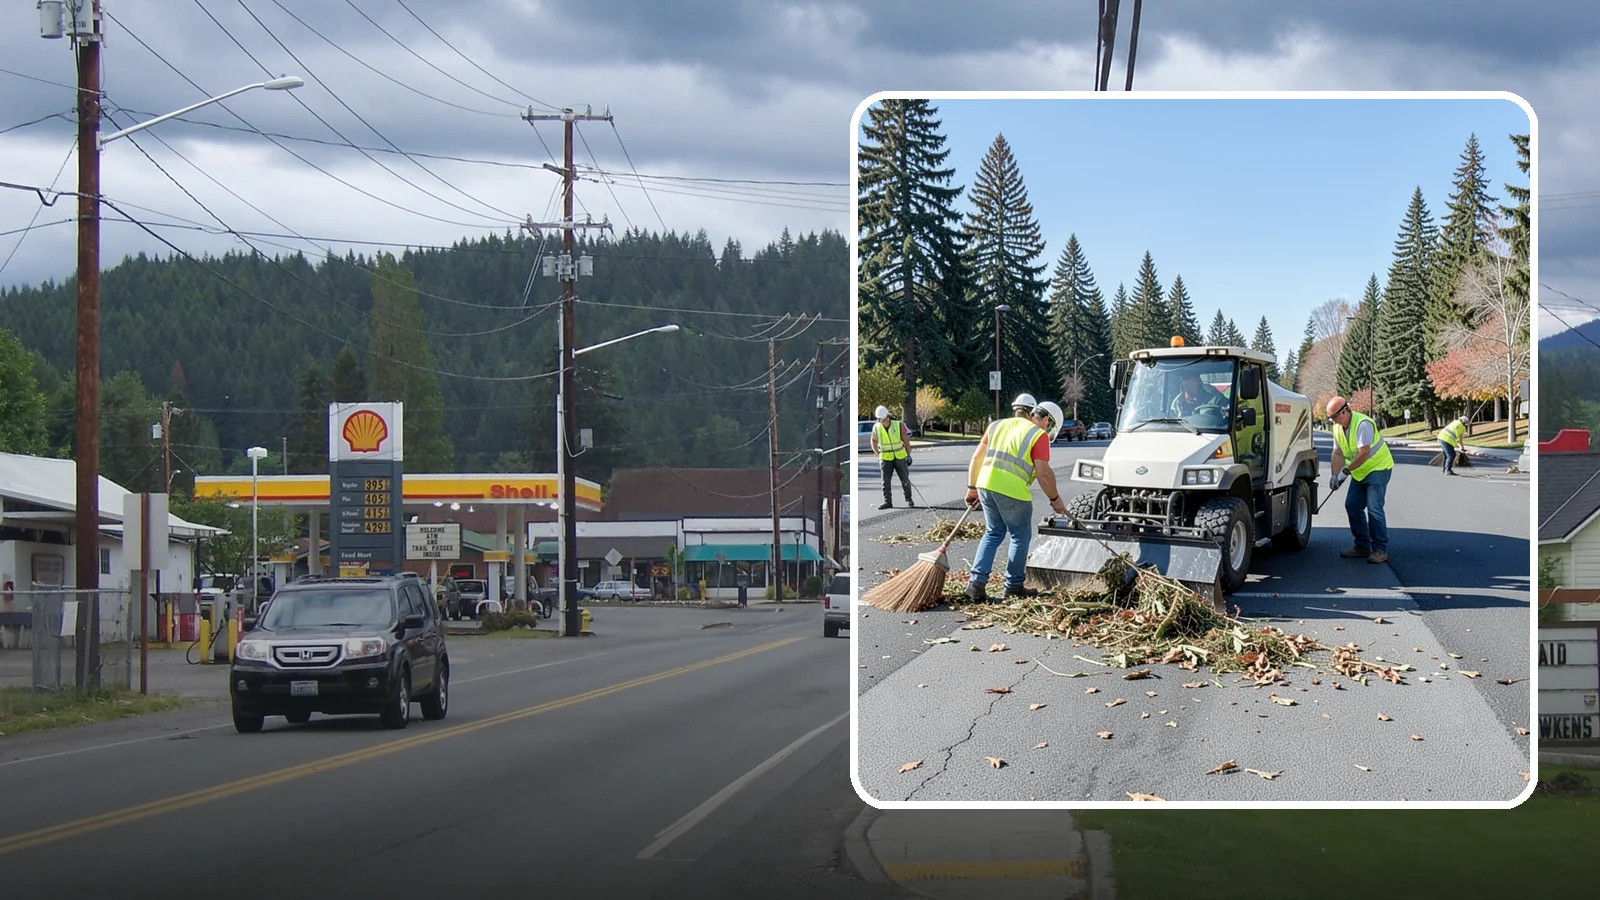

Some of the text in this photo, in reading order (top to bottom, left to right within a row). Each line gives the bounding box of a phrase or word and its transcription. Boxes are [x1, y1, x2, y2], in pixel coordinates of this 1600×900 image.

[366, 479, 383, 490] 395
[490, 484, 547, 499] Shell
[366, 494, 383, 504] 405
[366, 508, 383, 518] 415
[366, 522, 383, 532] 429
[1539, 642, 1567, 666] AID
